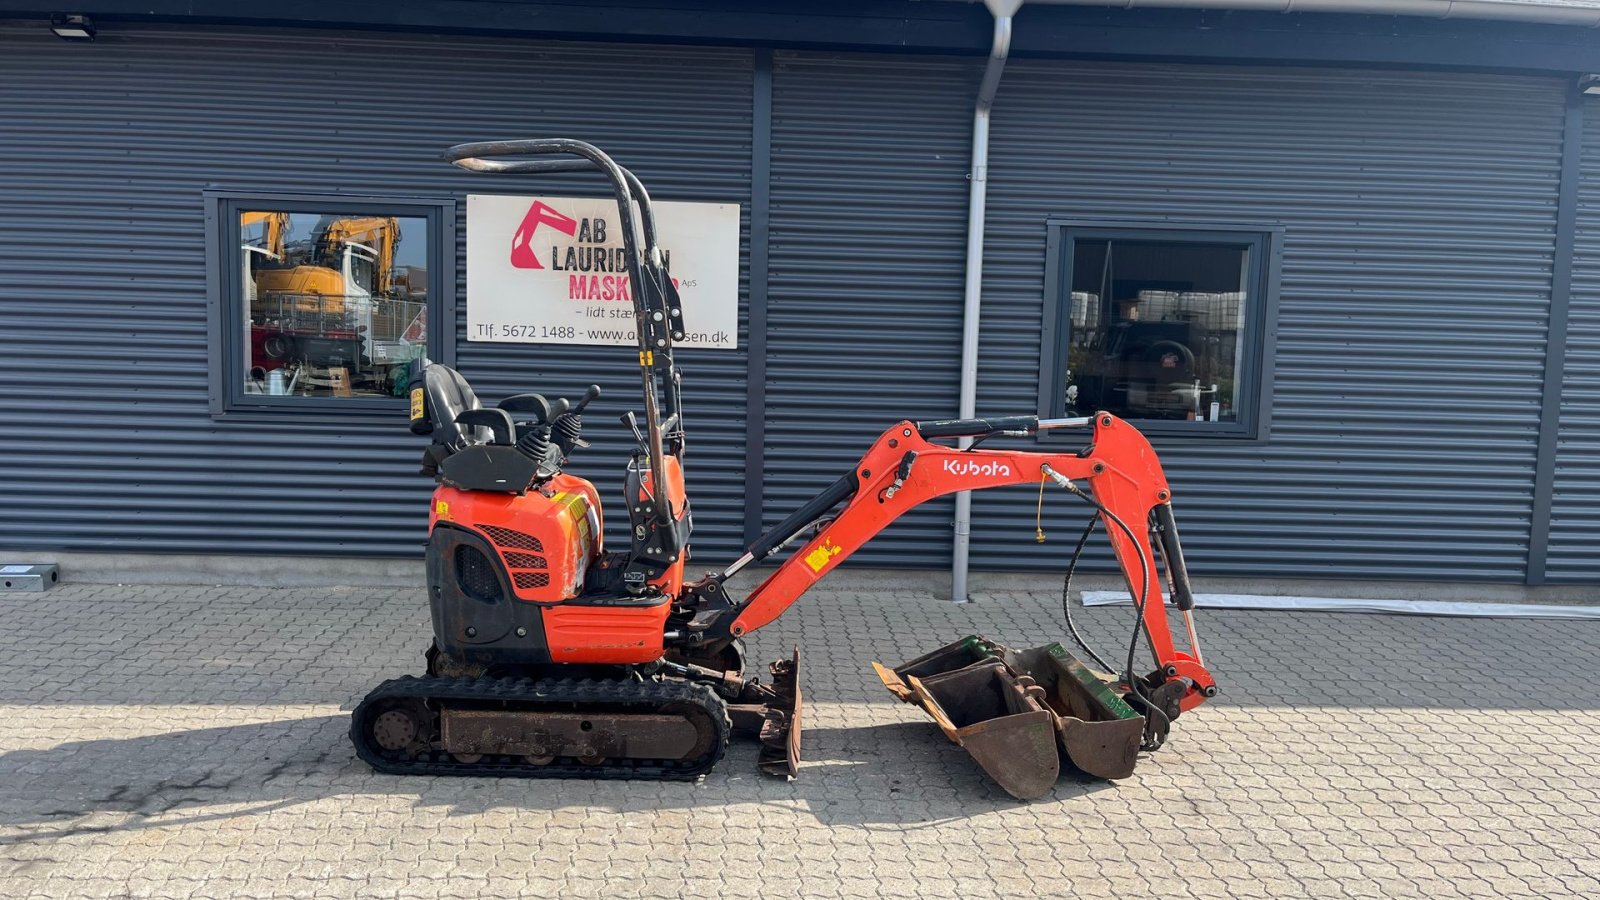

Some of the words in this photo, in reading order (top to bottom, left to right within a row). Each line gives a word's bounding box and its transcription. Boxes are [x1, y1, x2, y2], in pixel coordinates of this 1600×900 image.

[578, 217, 607, 243] AB
[552, 245, 671, 273] LAURIDN
[681, 279, 698, 289] ApS
[586, 306, 606, 318] lidt
[609, 307, 638, 319] stær
[476, 323, 498, 339] Tlf.
[501, 324, 537, 338] 5672
[541, 326, 575, 339] 1488
[943, 459, 1011, 477] Kubota
